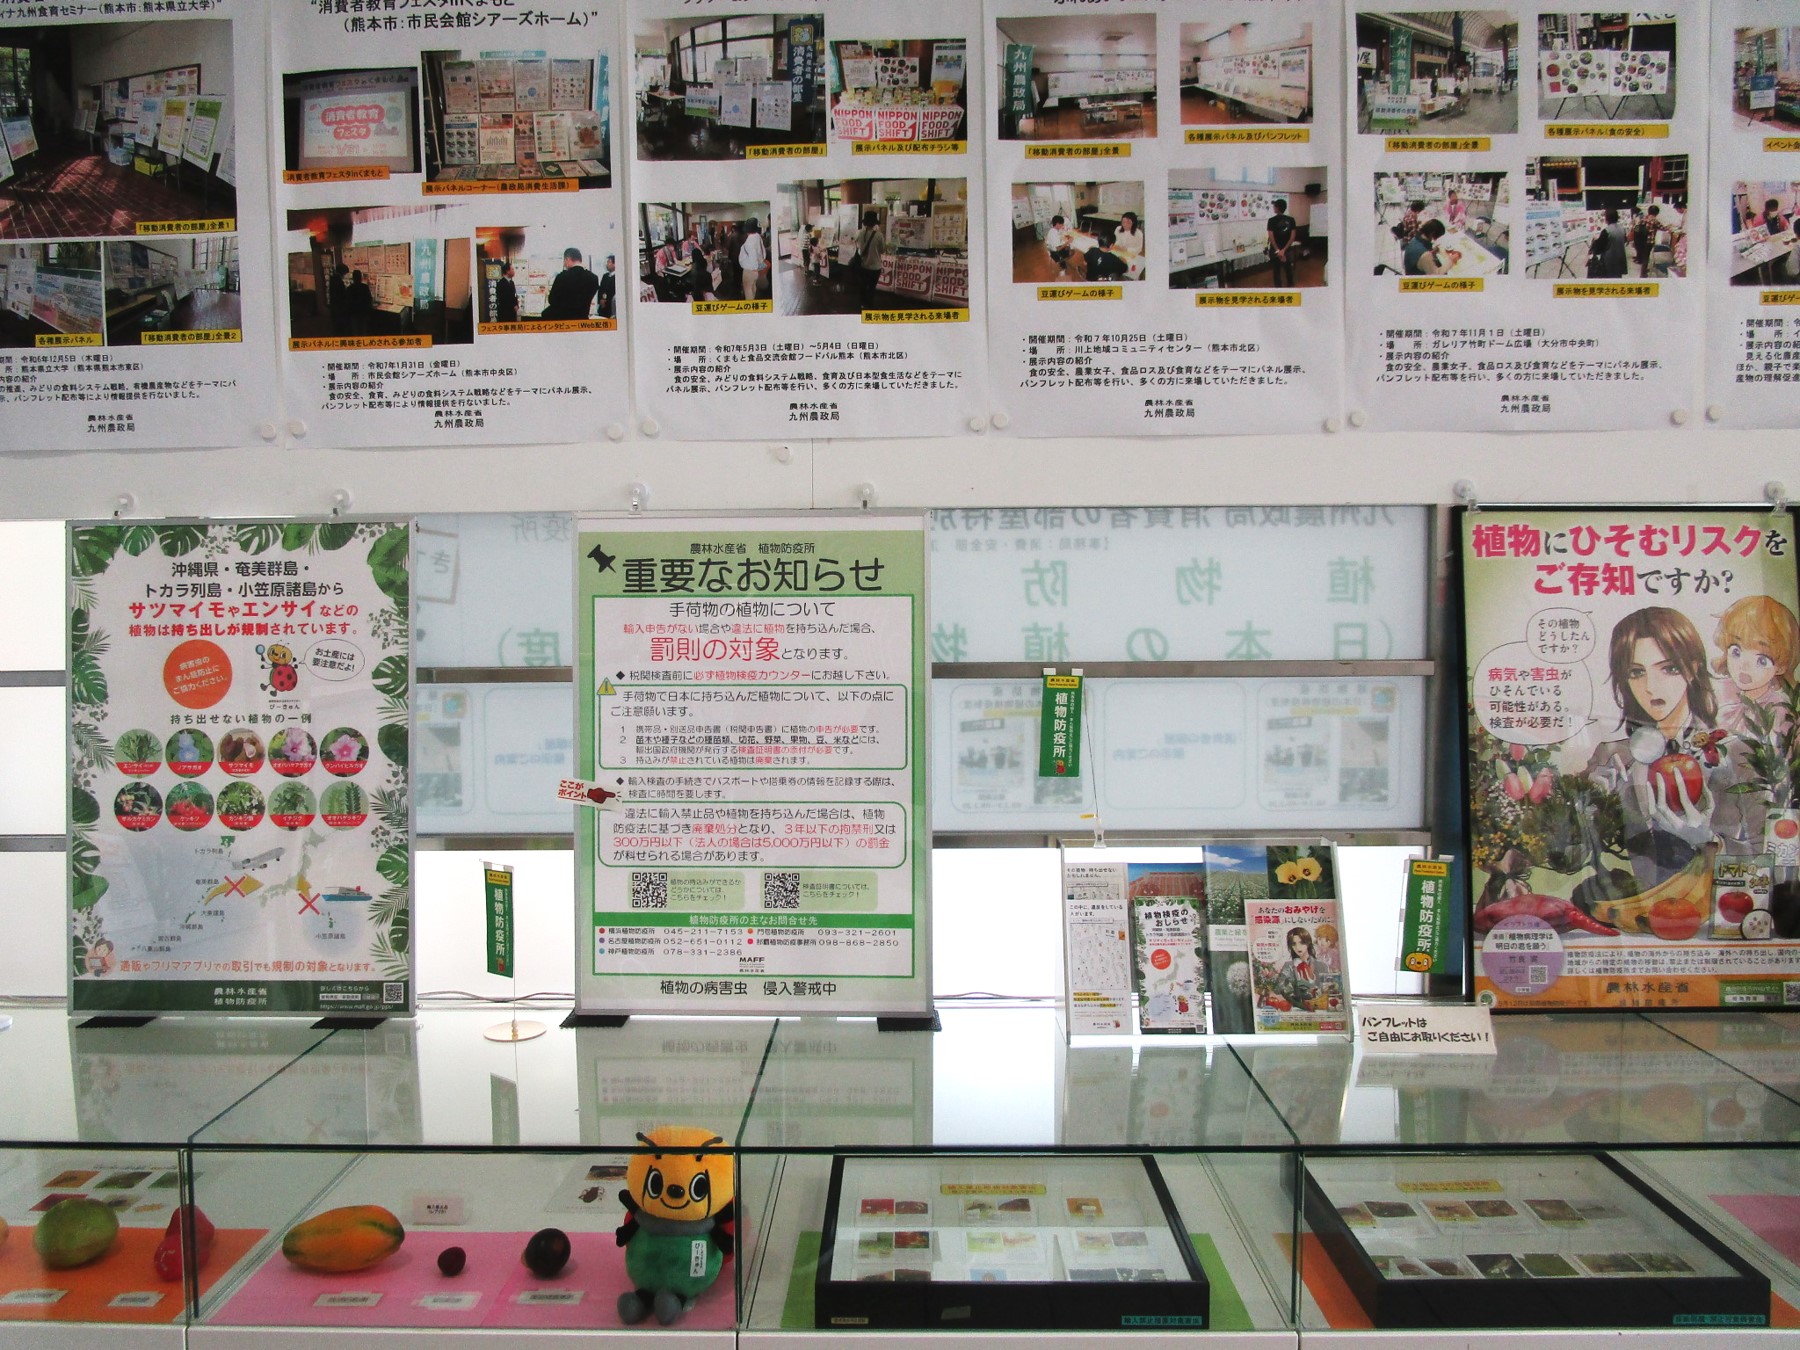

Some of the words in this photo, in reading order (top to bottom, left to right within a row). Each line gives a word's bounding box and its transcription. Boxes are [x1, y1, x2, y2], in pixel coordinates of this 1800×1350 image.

[1013, 49, 1027, 112] 九州農政局
[878, 111, 917, 120] NIPPON
[922, 110, 962, 120] NIPPON
[878, 120, 906, 129] FOOD
[922, 120, 949, 130] FOOD
[879, 129, 908, 138] SHIFT
[921, 128, 950, 138] SHIFT
[1188, 131, 1302, 142] 各種展示パネル及びパンフレット
[855, 143, 959, 153] 展示パネル及び配布チラシ等
[287, 170, 384, 182] 消費者教育フェスタinくまもと
[897, 262, 932, 273] NIPPON
[897, 272, 921, 281] FOOD
[936, 276, 965, 286] FOOD
[896, 280, 923, 290] SHIFT
[935, 285, 968, 296] SHIFT
[1402, 280, 1476, 292] 豆運びゲームの様子
[1041, 289, 1114, 299] 豆運びゲームの様子
[1556, 285, 1651, 297] 展示物を見学される来場者
[1199, 295, 1293, 305] 展示物を見学される来場者
[696, 302, 768, 313] 豆運びゲームの様子
[865, 311, 959, 321] 展示物を見学される来場者
[39, 336, 94, 344] 各種展示パネル
[1145, 399, 1193, 407] 農林水産省
[1501, 394, 1550, 402] 農林水産省
[1144, 408, 1195, 418] 九州農政局
[1500, 404, 1551, 413] 九州農政局
[788, 411, 840, 422] 九州農政局
[88, 422, 136, 433] 九州農政局
[434, 418, 484, 429] 九州農政局
[1472, 524, 1788, 558] 植物にひそむリスクを
[690, 542, 746, 554] 農林水産省
[758, 542, 815, 554] 植物防疫所
[622, 557, 885, 593] 重要なお知らせ
[1534, 564, 1734, 596] ご存知ですか？
[145, 582, 344, 598] トカラ列島・小笠原諸島から
[129, 601, 358, 619] サツマイモやエンサイなどの
[669, 602, 835, 618] 手荷物の植物について
[623, 623, 876, 634] 輸入申告がない場合や違法に植物を持ち込んだ場合、
[1538, 618, 1580, 629] その植物
[129, 623, 358, 637] 植物は持ち出しが規制されています。
[1538, 631, 1590, 642] どうしたん
[650, 637, 850, 662] 罰則の対象となります。
[1538, 643, 1579, 654] ですか？
[315, 647, 355, 662] お土産には
[180, 655, 209, 669] 病害虫の
[312, 658, 355, 672] 要注意だよ！
[175, 665, 220, 683] まん延防止に
[629, 670, 891, 681] 税関検査前に必ず植物検疫カウンターにお越し下さい。
[1488, 668, 1572, 683] 病気や害虫が
[173, 675, 227, 694] ご協力ください。
[623, 691, 894, 702] 手荷物で日本に持ち込んだ植物について、以下の点に
[1489, 685, 1562, 697] ひそんでいる
[611, 706, 694, 717] ご注意願います。
[1489, 700, 1570, 713] 可能性がある。
[171, 714, 312, 725] 持ち出せない植物の一例
[1053, 692, 1068, 758] 植物防疫所
[1489, 716, 1573, 729] 検査が必要だ！
[560, 780, 585, 790] ここが
[557, 787, 587, 800] ポイント
[628, 789, 727, 799] 検査に時間を要します。
[625, 807, 885, 819] 違法に輸入禁止品や植物を持ち込んだ場合は、植物
[613, 850, 765, 862] が科せられる場合があります。
[1719, 863, 1757, 878] トマトの
[1144, 908, 1188, 919] 植物検疫の
[1258, 905, 1325, 914] あなたのおみやげを
[494, 888, 505, 955] 植物防疫所
[689, 915, 818, 926] 植物防疫所の主なお問合せ先
[1417, 880, 1435, 952] 植物防疫所
[1156, 917, 1188, 927] おしらせ
[608, 927, 655, 935] 横浜植物防疫所
[608, 937, 661, 945] 名古屋植物防疫所
[756, 938, 817, 946] 那覇植物防疫事務所
[608, 948, 655, 956] 神戸植物防疫所
[120, 960, 376, 972] 通販やフリマアプリでの取引でも規制の対象となります。
[214, 987, 267, 996] 農林水産省
[660, 980, 748, 996] 植物の病害虫
[763, 981, 838, 996] 侵入警戒中
[1606, 982, 1690, 993] 農林水産省
[214, 997, 268, 1005] 植物防疫所
[1362, 1016, 1428, 1028] パンフレットは
[1367, 1031, 1489, 1042] ご自由にお取りください！
